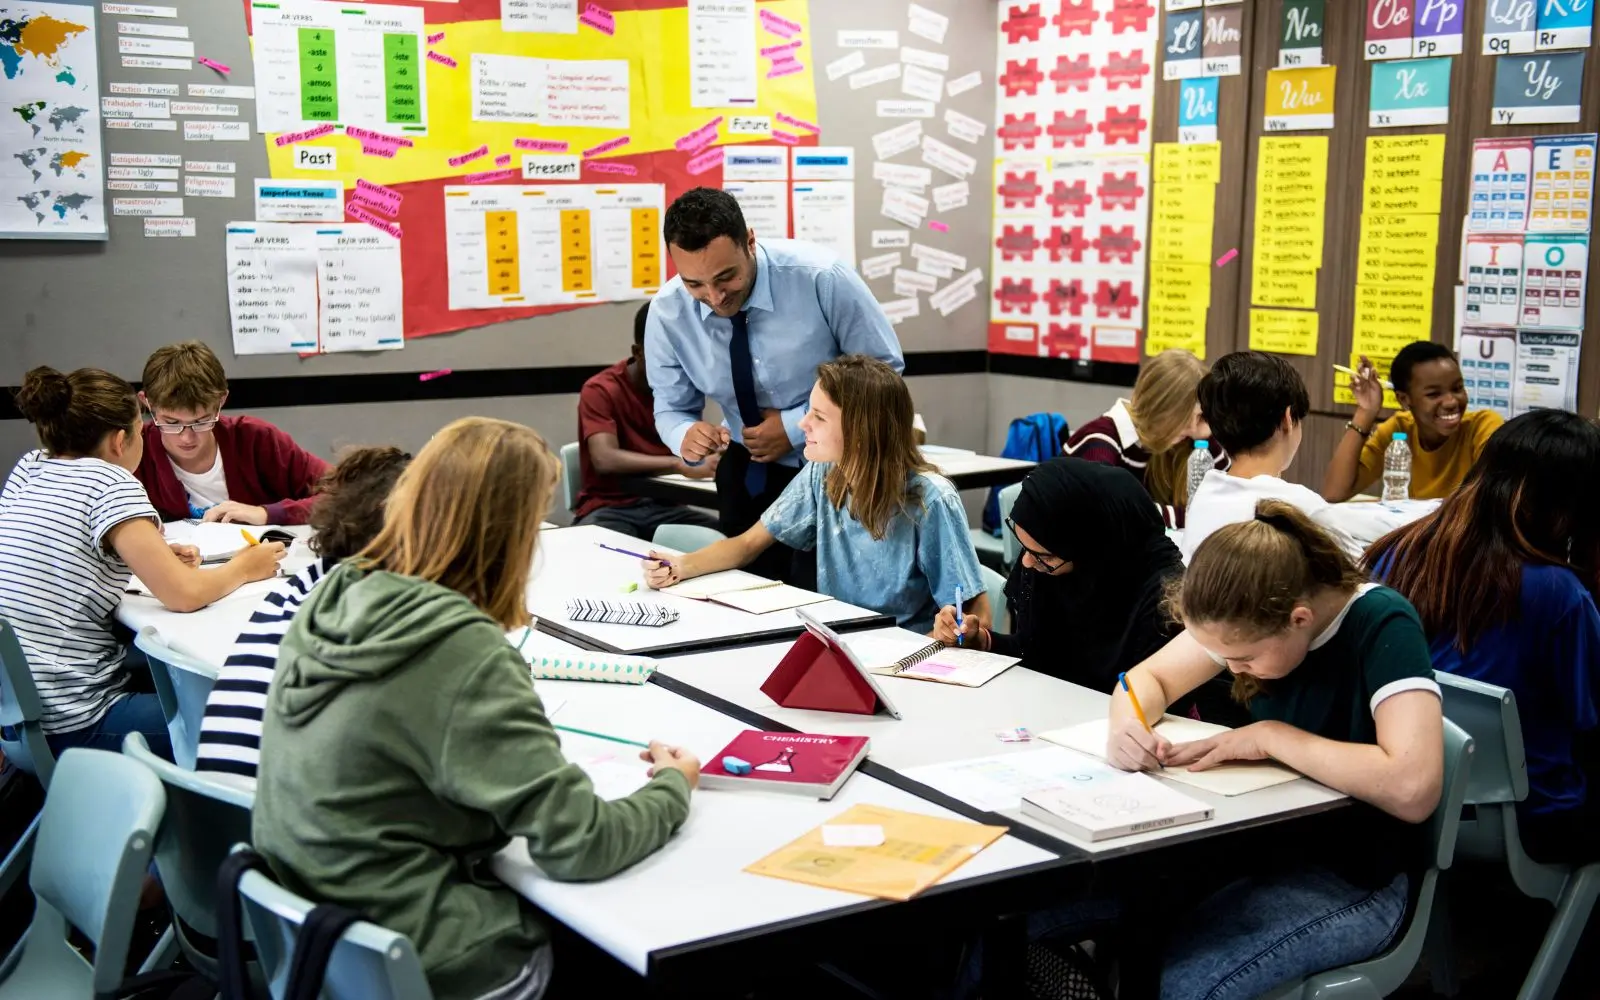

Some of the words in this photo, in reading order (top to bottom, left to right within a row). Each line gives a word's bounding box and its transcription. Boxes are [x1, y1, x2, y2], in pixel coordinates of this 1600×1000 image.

[1372, 0, 1409, 29] Oo
[1420, 0, 1457, 32] Pp
[1490, 0, 1535, 31] Qq
[1285, 7, 1321, 42] Nn
[1167, 20, 1198, 53] Ll
[1203, 16, 1241, 46] Mm
[1368, 44, 1387, 55] Oo
[1419, 41, 1436, 55] Pp
[1489, 38, 1510, 54] Qq
[1540, 33, 1556, 45] Rr
[1284, 55, 1301, 64] Nn
[1207, 62, 1228, 72] Mm
[1395, 68, 1429, 100] Xx
[1523, 60, 1562, 100] Yy
[1280, 80, 1323, 108] Ww
[734, 118, 768, 130] Future
[1377, 114, 1391, 124] Xx
[1498, 110, 1514, 124] Yy
[1269, 121, 1288, 129] Ww
[357, 128, 367, 137] fin
[370, 131, 379, 140] de
[300, 150, 331, 164] Past
[1493, 151, 1508, 171] A
[1549, 149, 1561, 170] E
[528, 162, 576, 174] Present
[260, 189, 300, 197] Imperfect
[1488, 246, 1499, 265] I
[1544, 246, 1564, 267] O
[348, 329, 367, 337] They
[1480, 340, 1494, 359] U
[763, 736, 838, 744] CHEMISTRY
